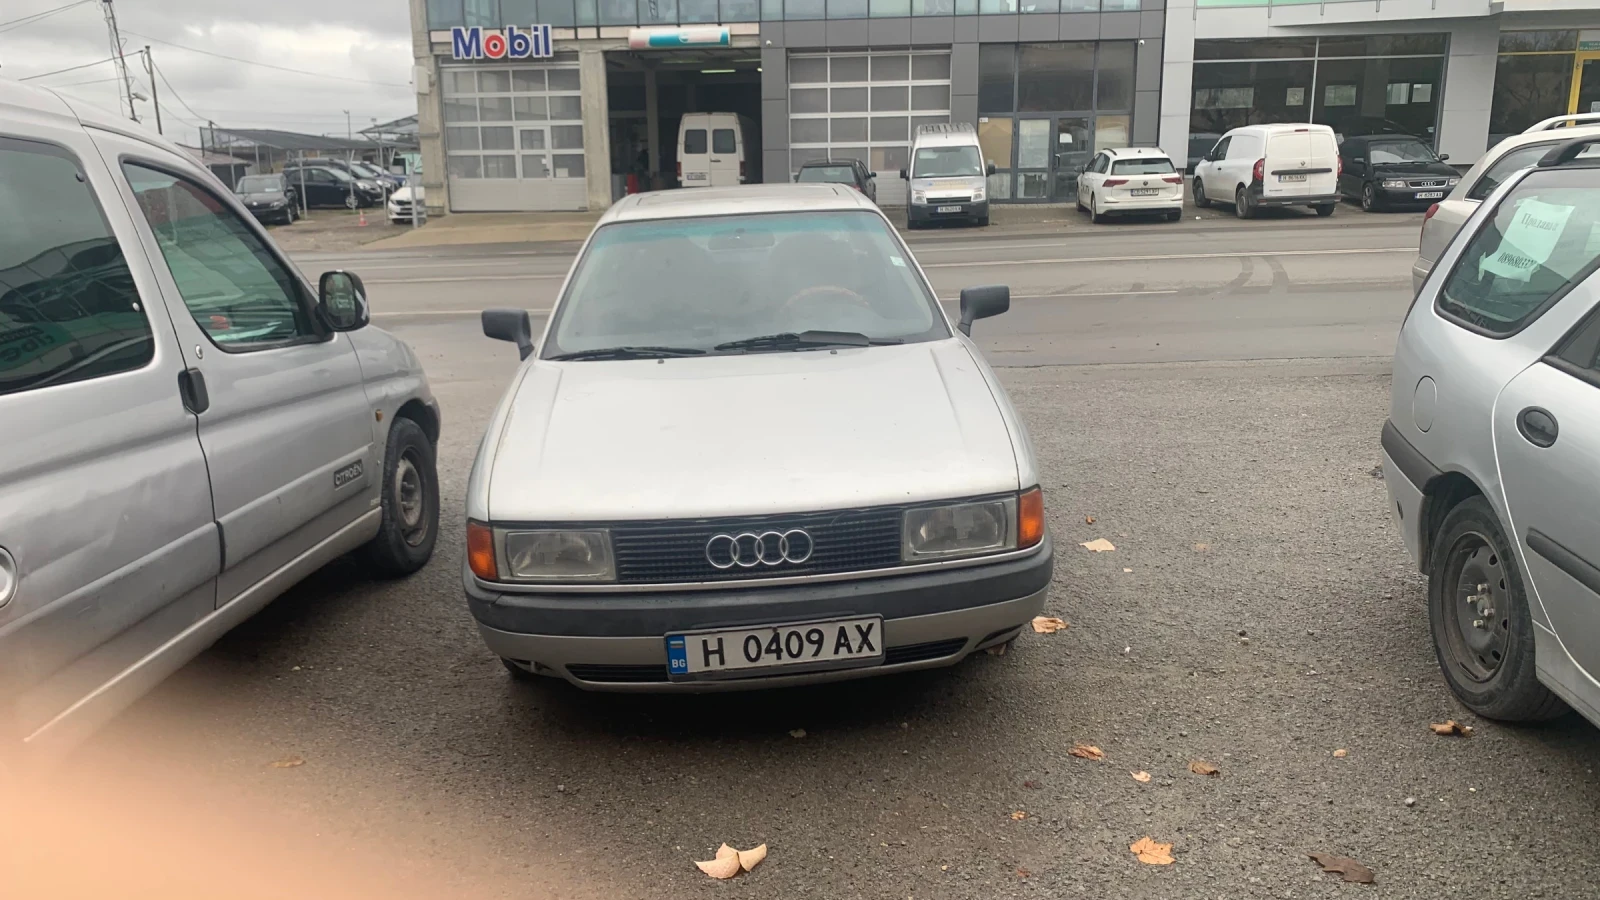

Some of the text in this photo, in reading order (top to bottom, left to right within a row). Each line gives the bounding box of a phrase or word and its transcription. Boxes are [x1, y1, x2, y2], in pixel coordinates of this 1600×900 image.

[452, 25, 551, 58] Mobil
[702, 623, 876, 667] H 0409 AX
[671, 659, 686, 668] BG
